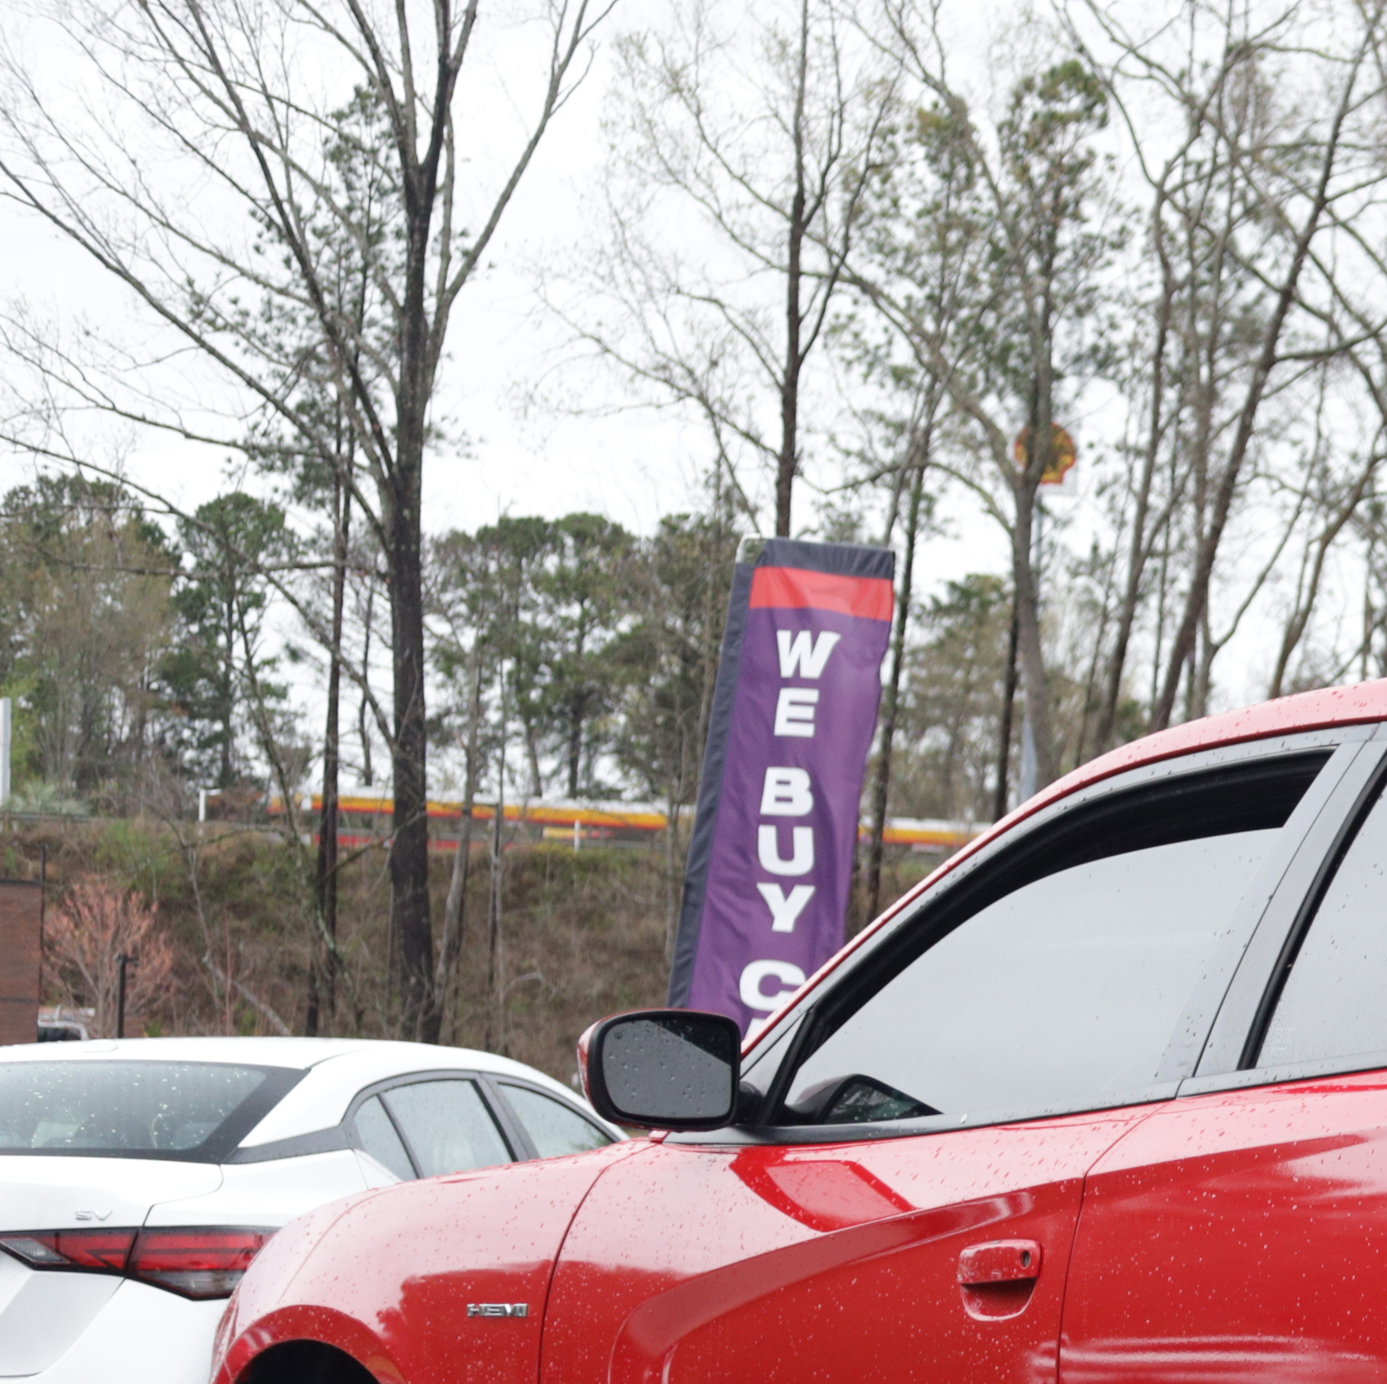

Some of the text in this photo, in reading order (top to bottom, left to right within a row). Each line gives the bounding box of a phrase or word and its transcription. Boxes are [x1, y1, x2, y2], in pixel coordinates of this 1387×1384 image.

[739, 629, 841, 1046] WE BUY C
[75, 1209, 113, 1221] SV
